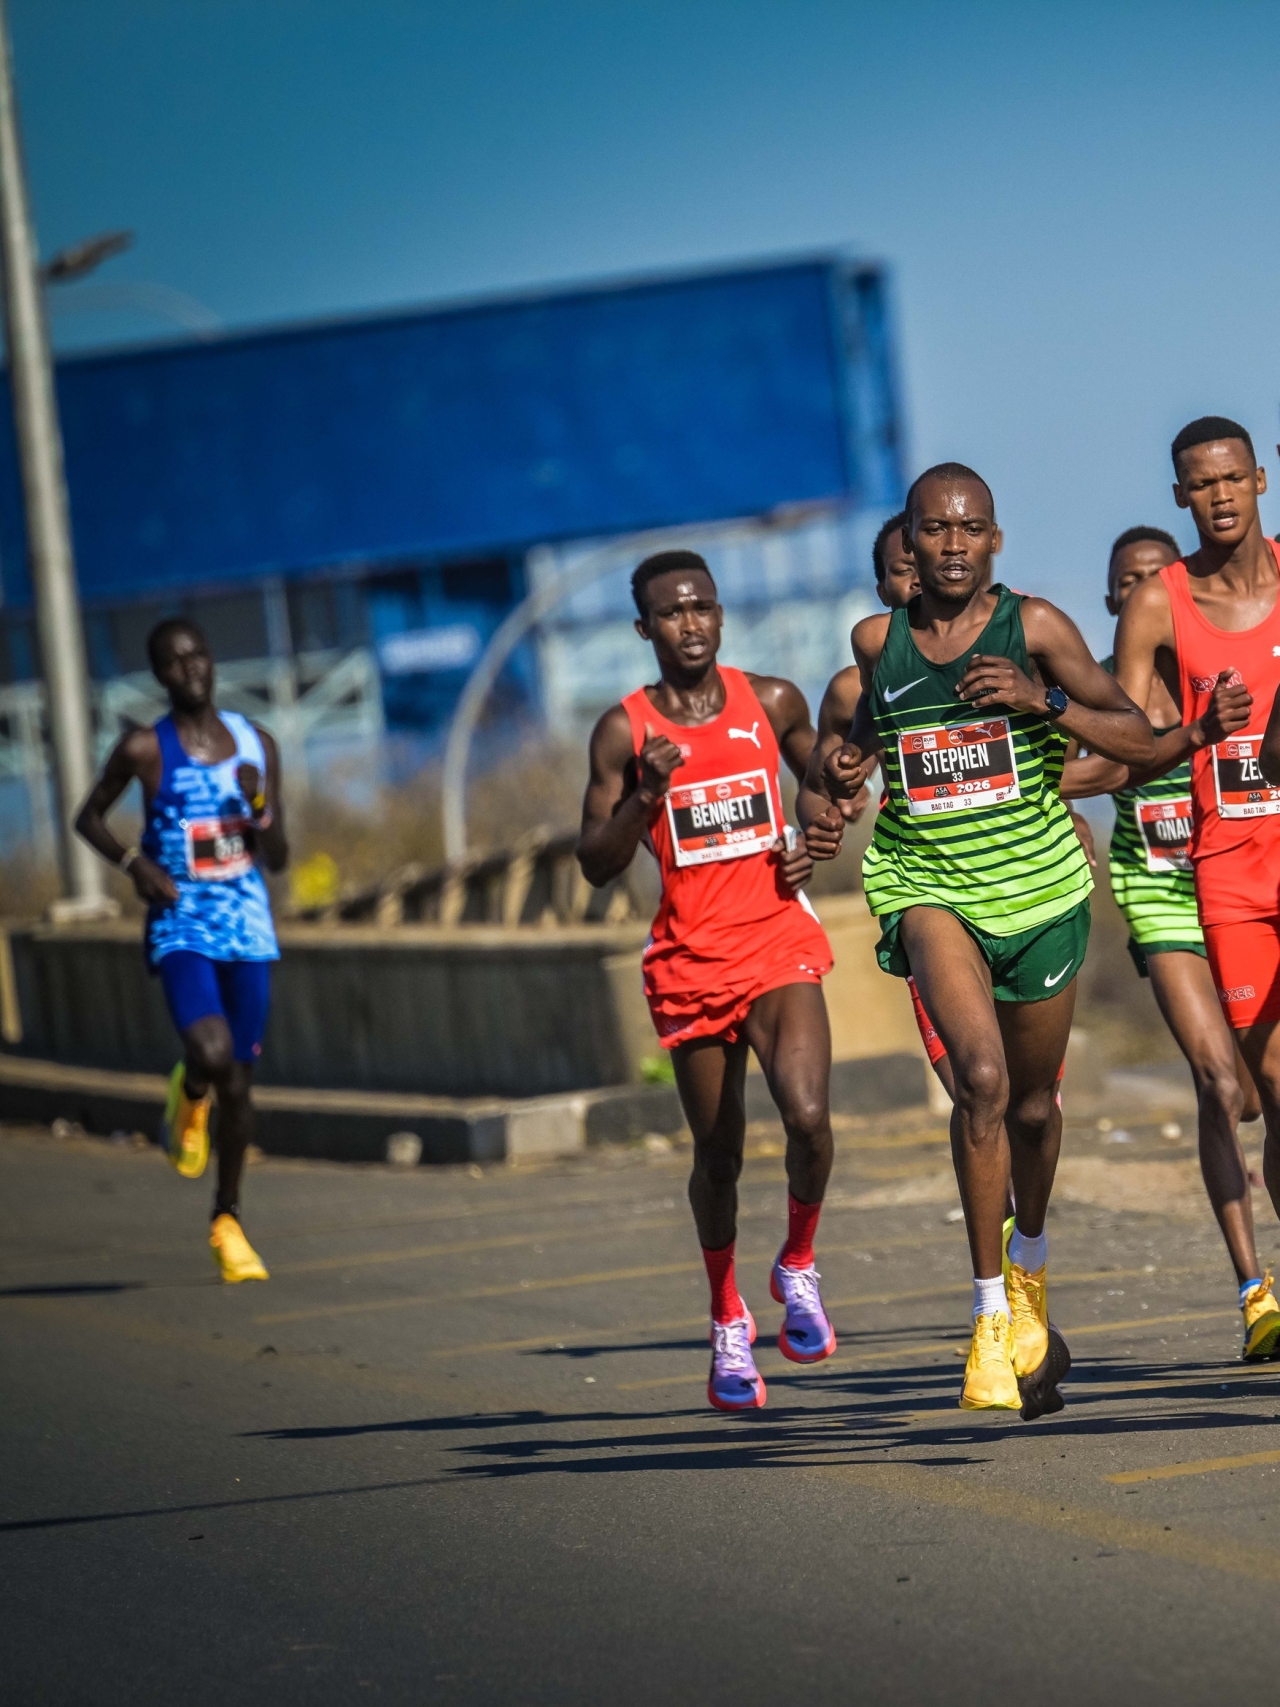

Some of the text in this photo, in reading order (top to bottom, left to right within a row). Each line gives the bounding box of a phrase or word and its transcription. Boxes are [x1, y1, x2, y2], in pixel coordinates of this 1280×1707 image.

[921, 743, 990, 776] STEPHEN
[951, 771, 963, 783] 33
[956, 780, 991, 794] 2026
[943, 801, 954, 809] TAG
[963, 798, 972, 806] 33
[1255, 806, 1266, 814] TAG
[690, 795, 754, 829] BENNETT
[724, 828, 756, 844] 2026
[1155, 816, 1194, 841] ONAL
[1218, 985, 1255, 1002] XER
